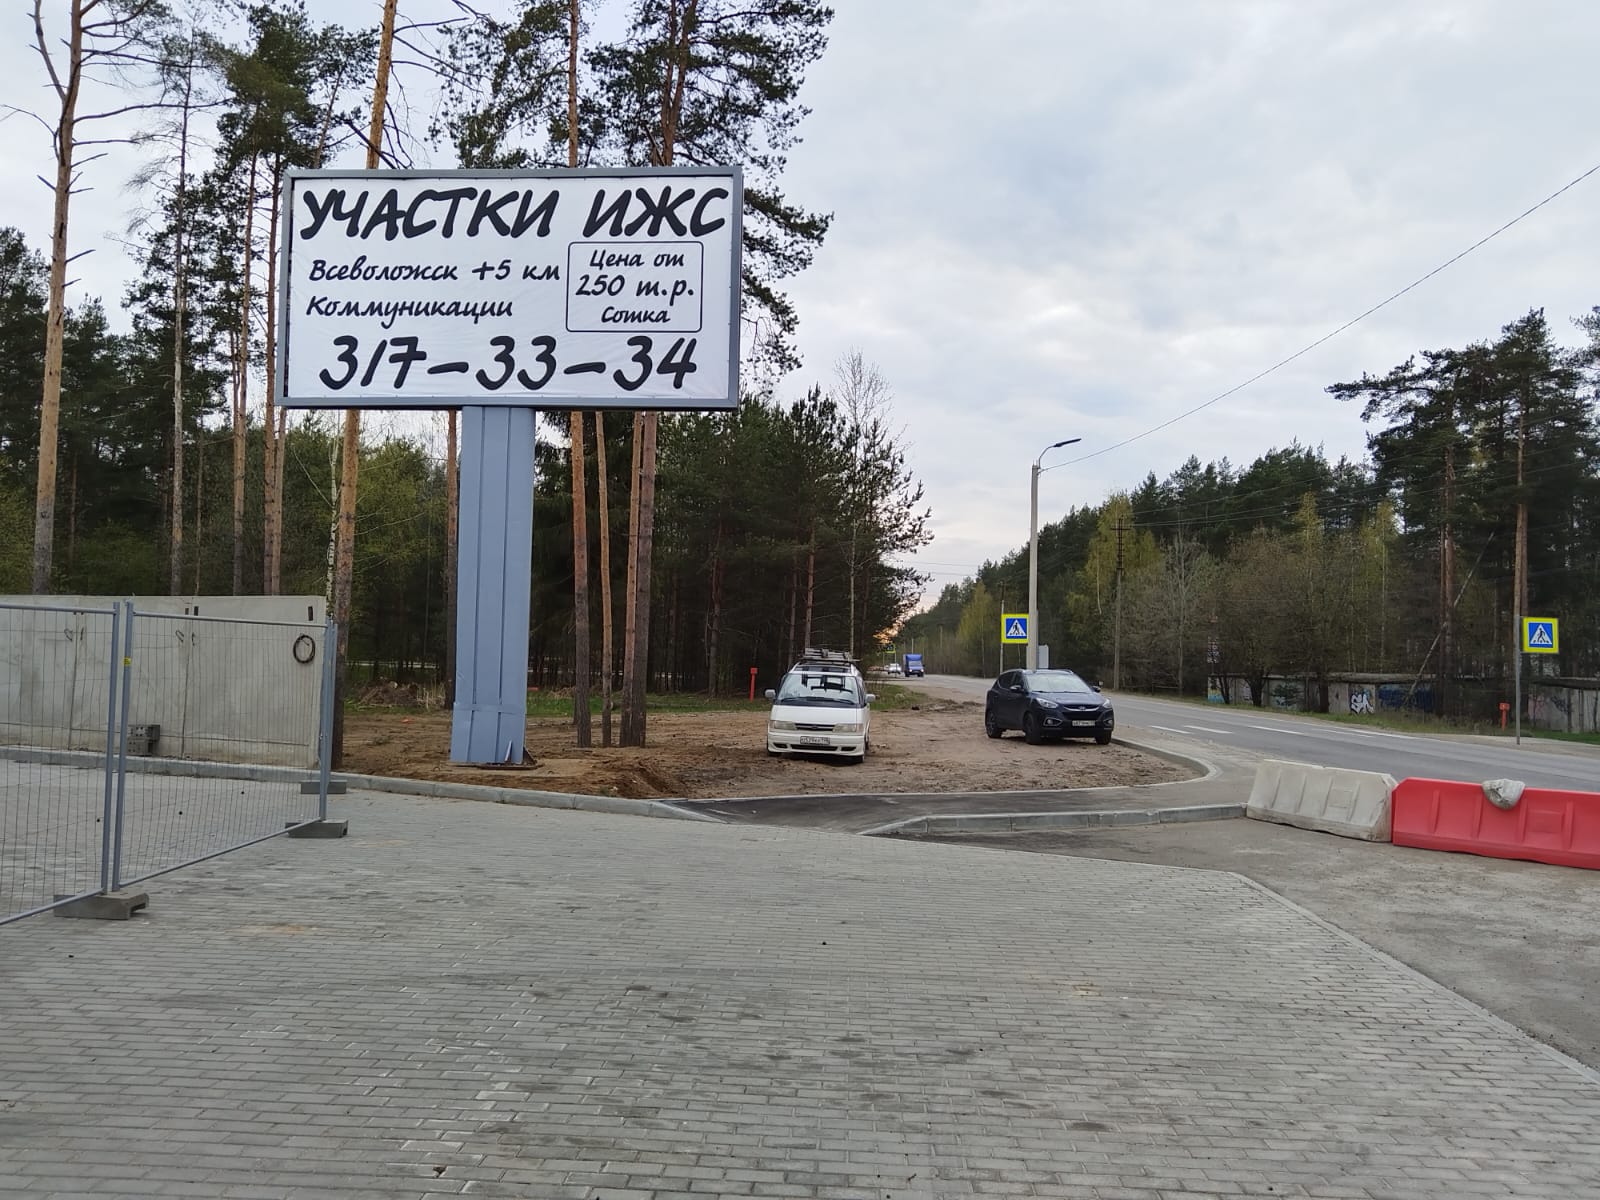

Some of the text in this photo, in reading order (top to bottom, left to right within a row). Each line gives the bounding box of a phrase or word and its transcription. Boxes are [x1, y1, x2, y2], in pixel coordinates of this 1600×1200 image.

[300, 186, 729, 241] УЧАСТКИ ИЖС
[308, 255, 561, 282] Всеволожск +5 км
[589, 249, 685, 270] Цена от
[575, 275, 696, 306] 250 т.р.
[305, 295, 514, 330] Коммуникации
[600, 303, 674, 324] Сотка
[318, 335, 698, 391] 317-33-34
